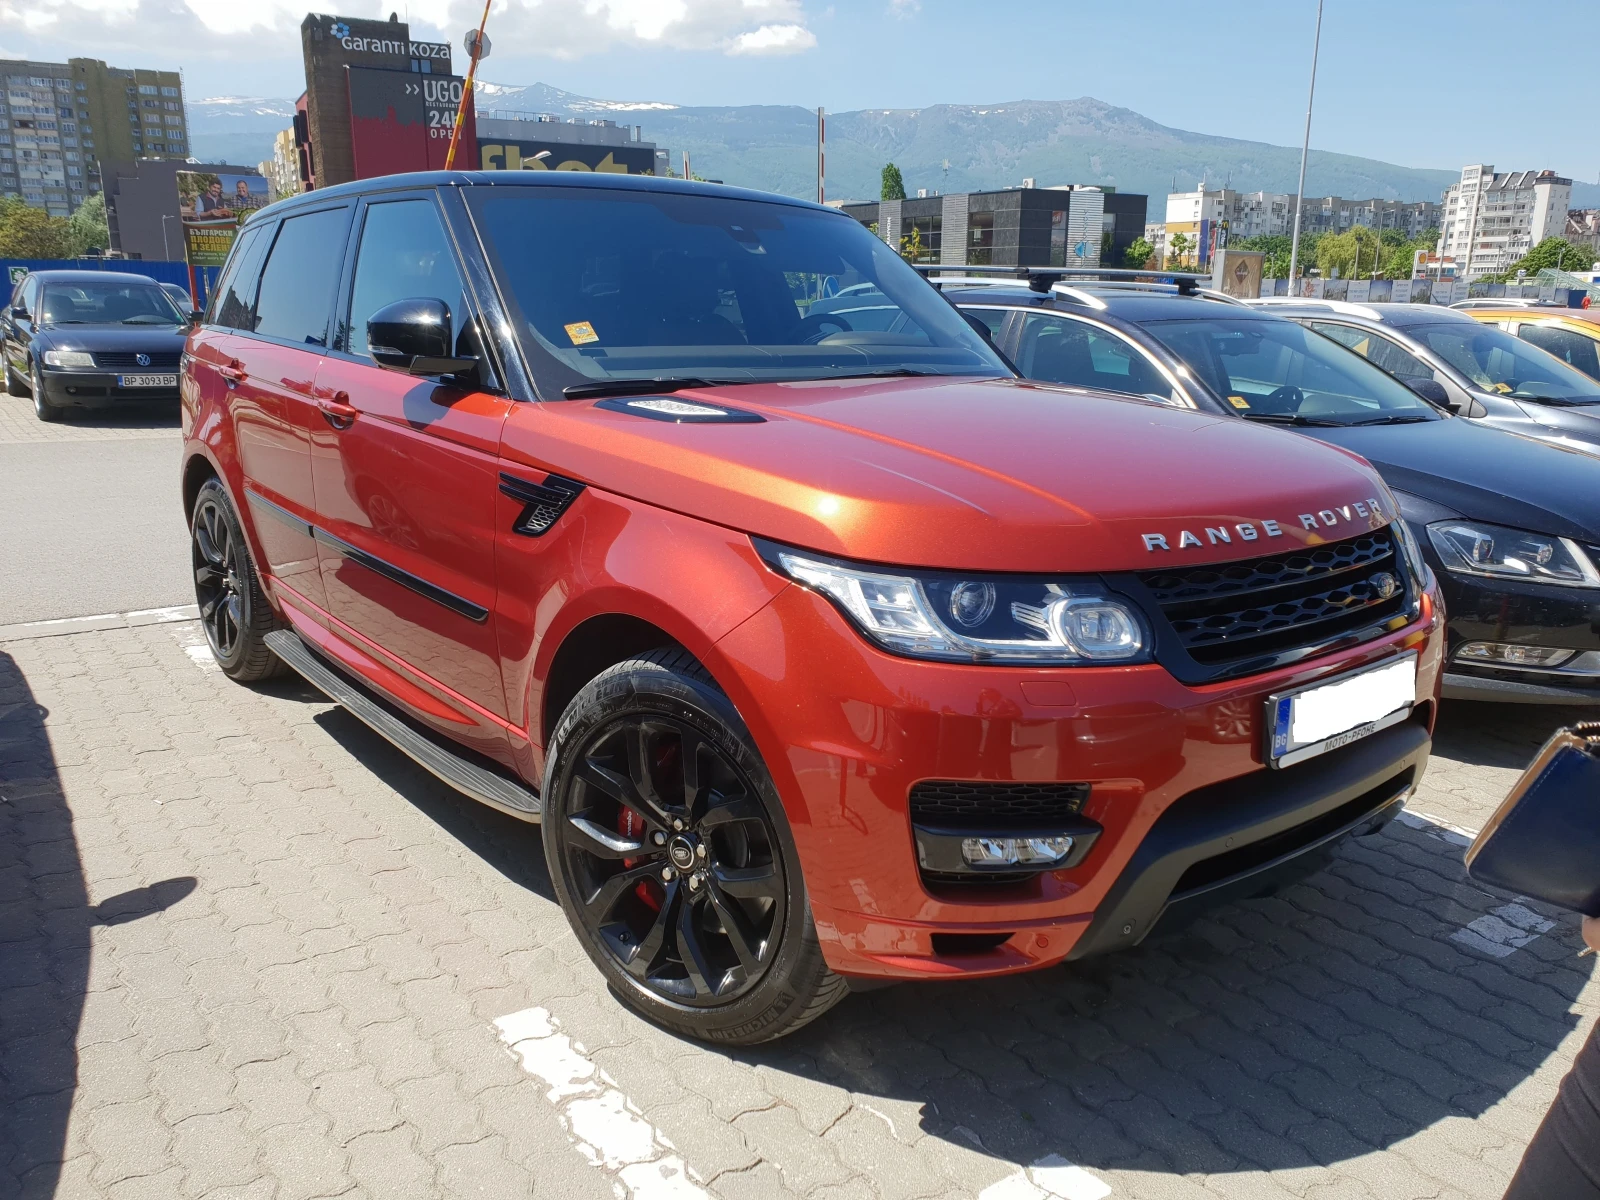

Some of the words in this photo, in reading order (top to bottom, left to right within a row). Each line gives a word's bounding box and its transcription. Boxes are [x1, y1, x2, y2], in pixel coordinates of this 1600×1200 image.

[423, 80, 462, 102] UGO
[426, 101, 460, 109] RESTAURANT
[190, 235, 231, 244] ПЛОДОВЕ
[124, 376, 137, 386] BP
[138, 376, 161, 386] 3093
[162, 376, 175, 386] BP
[1141, 519, 1283, 552] RANGE
[1298, 497, 1382, 531] ROVER
[1275, 733, 1288, 748] BG
[1323, 723, 1377, 752] MOTO-PFOHE
[711, 1007, 779, 1039] MICHELIN
